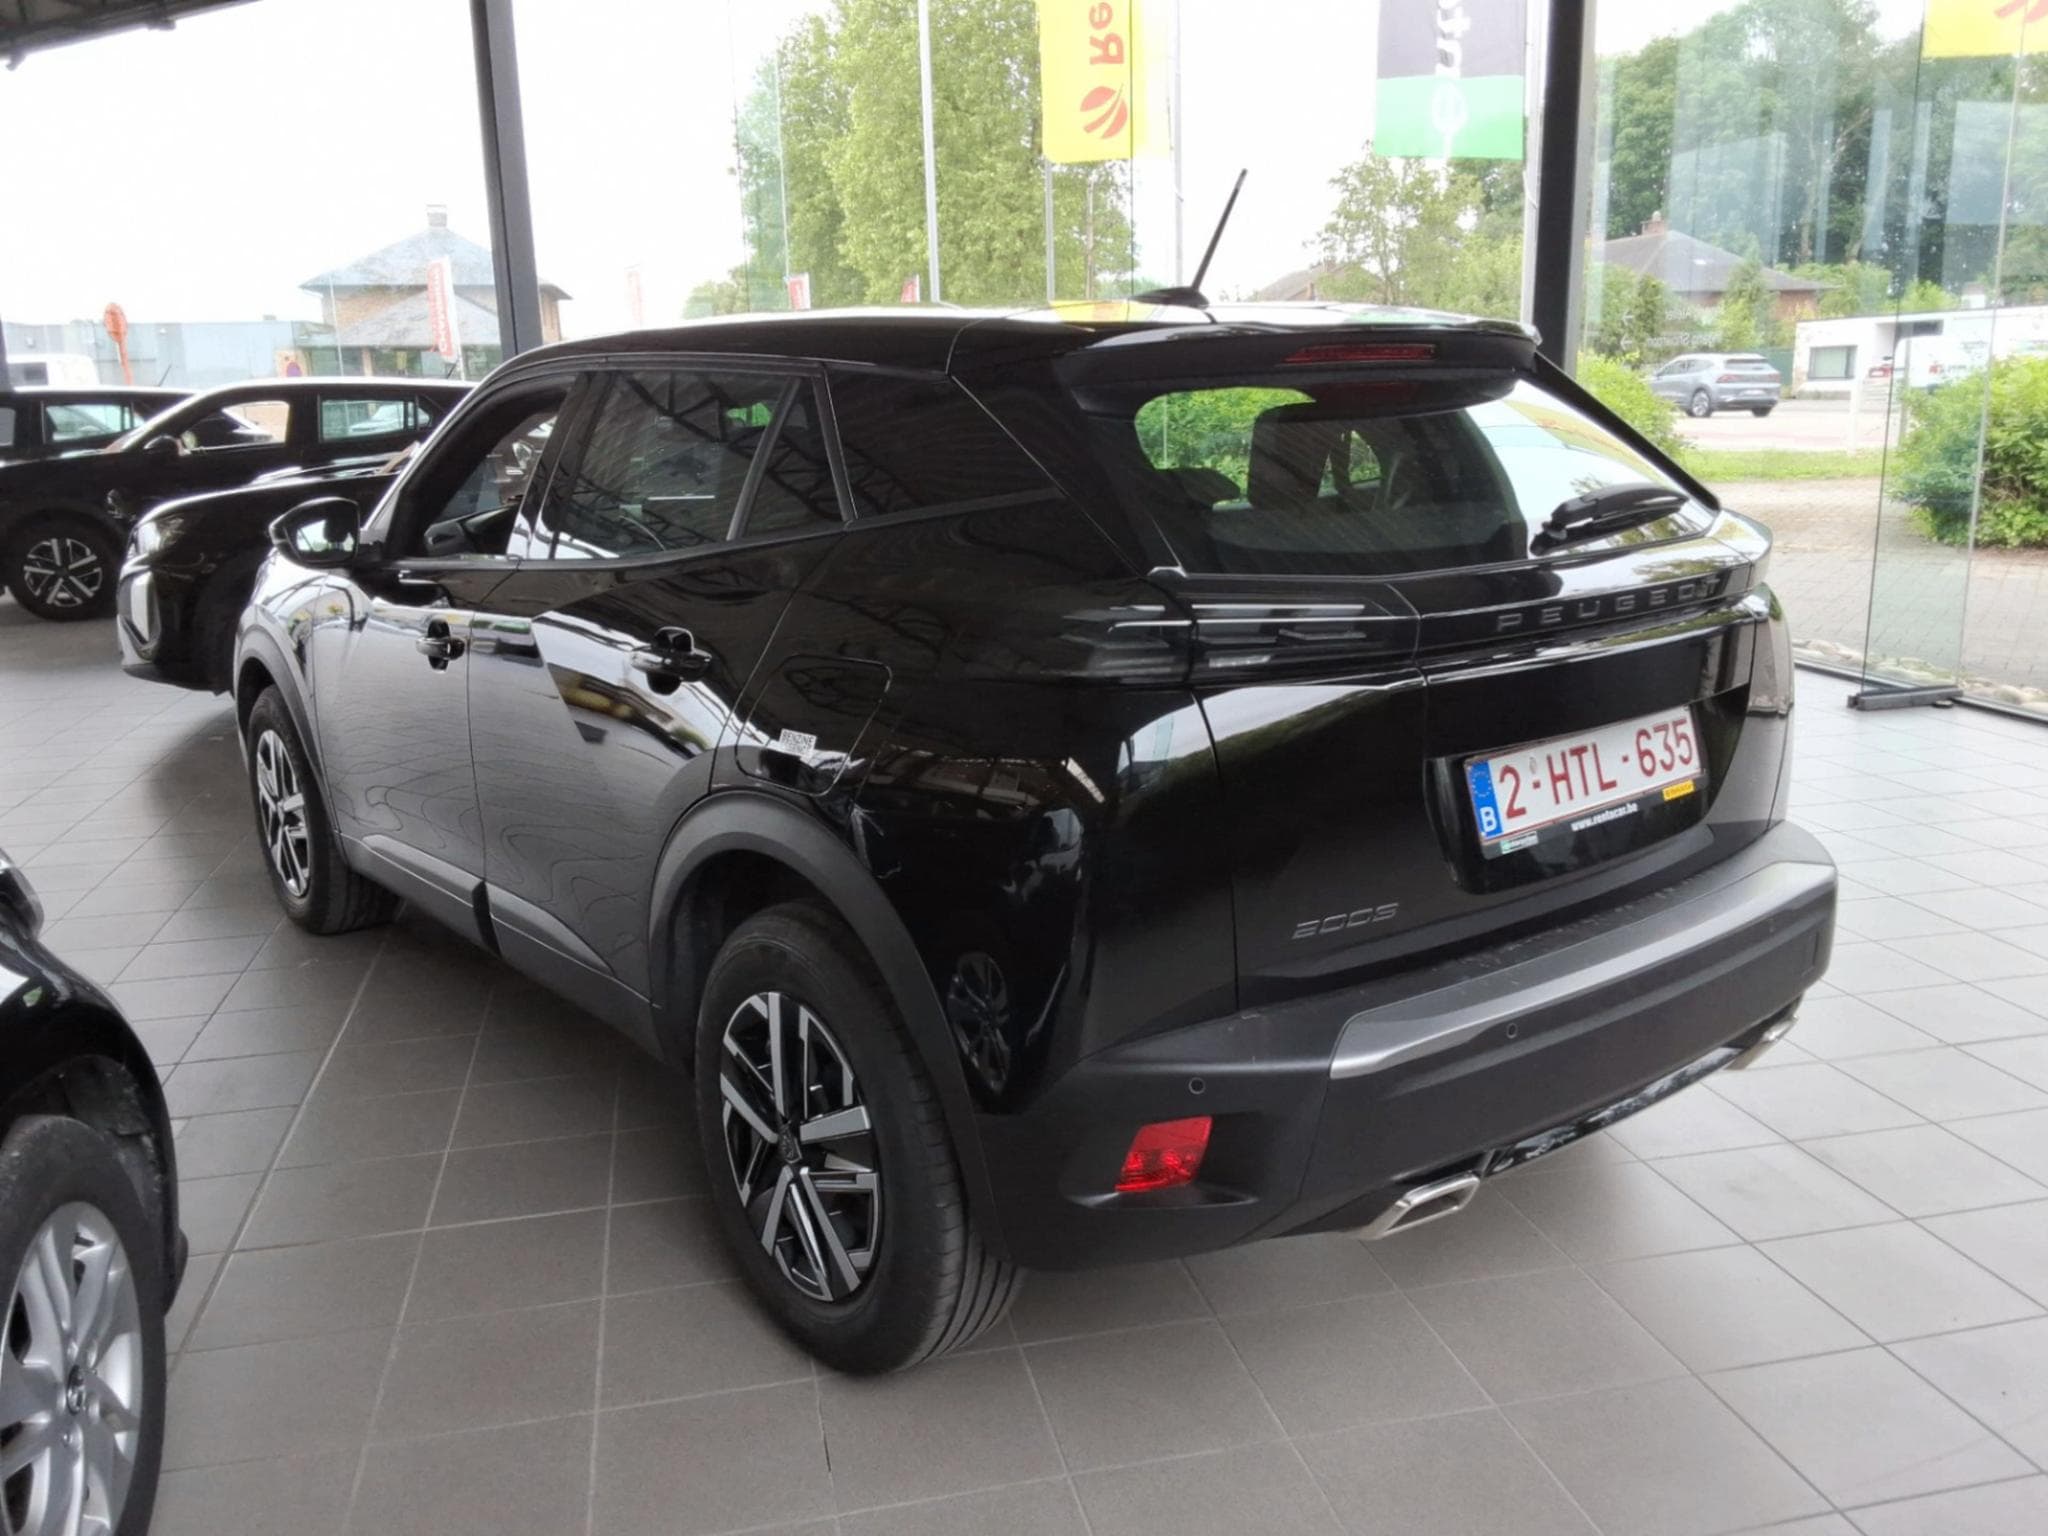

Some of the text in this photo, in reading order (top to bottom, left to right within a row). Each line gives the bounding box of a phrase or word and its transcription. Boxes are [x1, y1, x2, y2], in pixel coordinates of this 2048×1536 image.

[1497, 577, 1721, 632] PEUGEOT
[1499, 717, 1694, 819] 2-HTL-635
[1479, 805, 1497, 832] B
